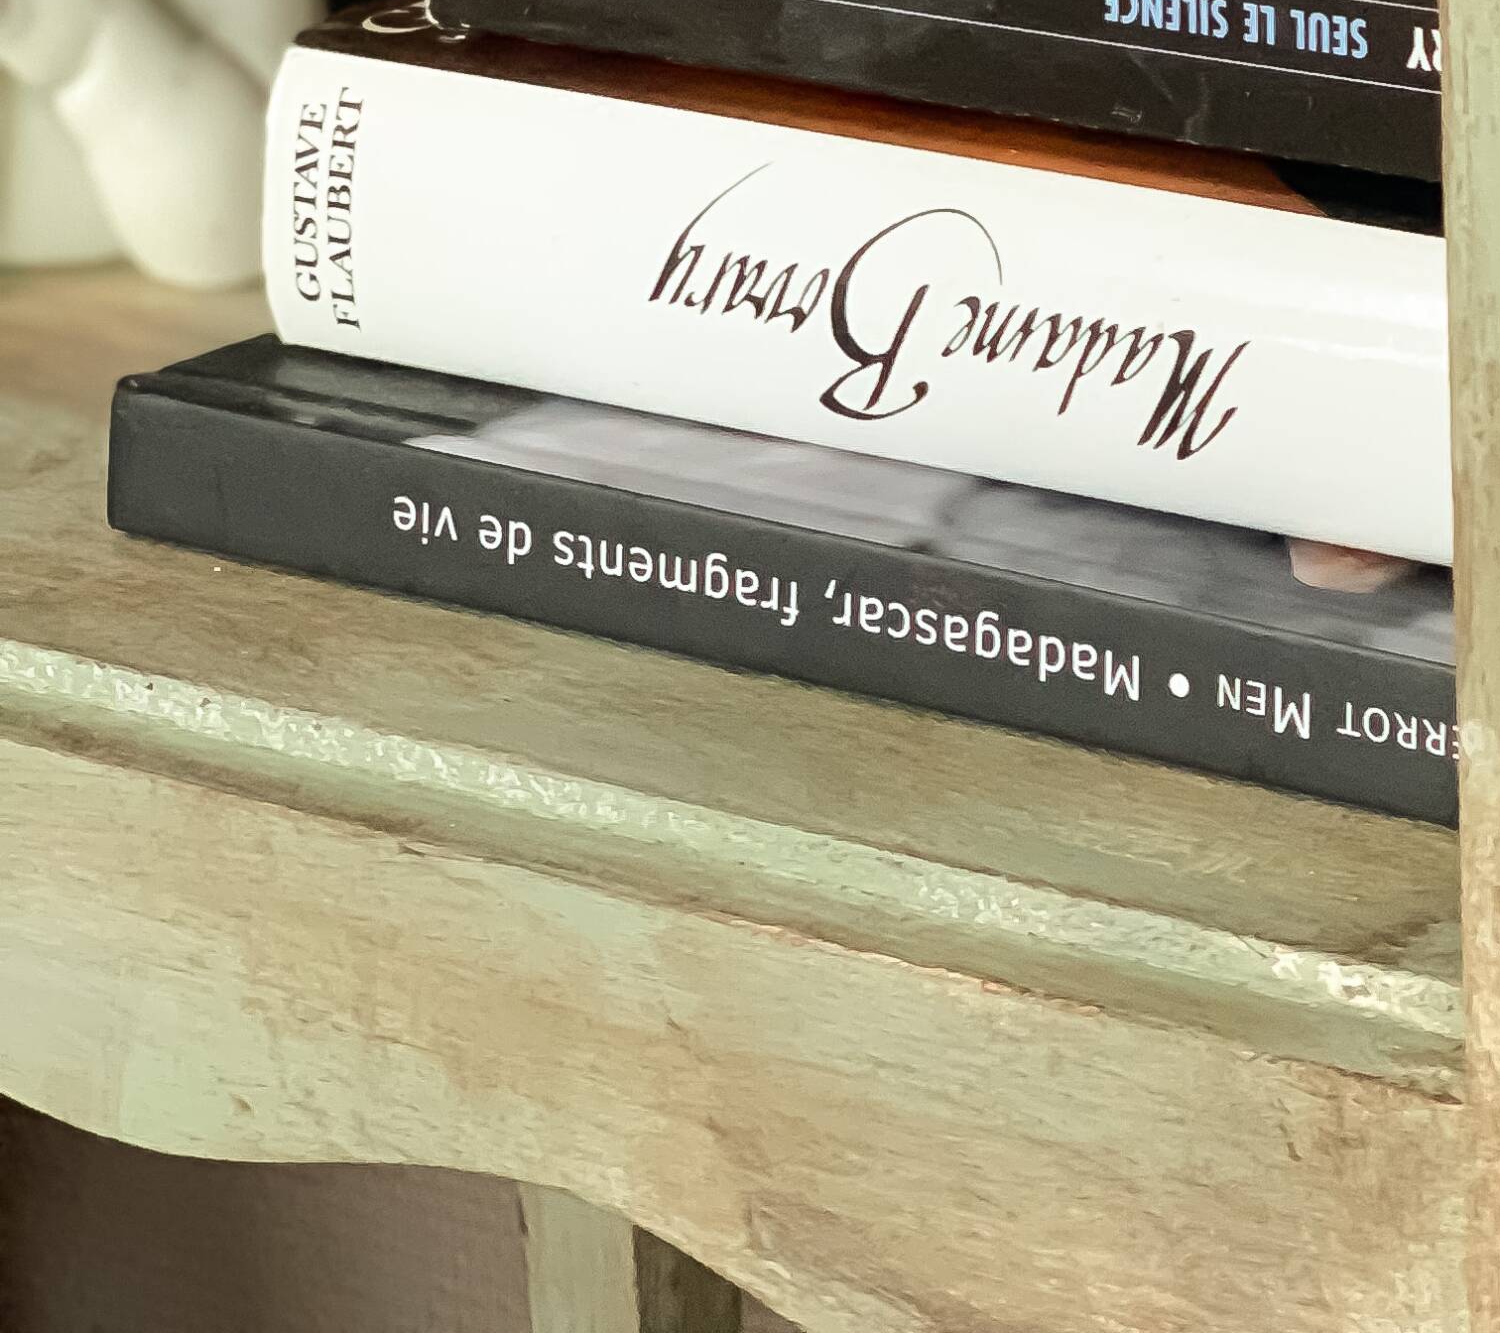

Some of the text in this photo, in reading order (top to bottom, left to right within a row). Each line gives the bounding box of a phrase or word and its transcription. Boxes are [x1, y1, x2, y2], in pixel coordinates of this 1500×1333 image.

[1243, 2, 1275, 46] LE
[1290, 8, 1369, 60] SEUL
[293, 102, 327, 302] GUSTAVE
[327, 86, 364, 333] FLAUBERT
[648, 161, 1251, 461] Madame Bovary
[392, 495, 458, 546] vie
[477, 514, 532, 565] de
[552, 530, 800, 627] fragments
[823, 579, 1140, 702] Madagascar,
